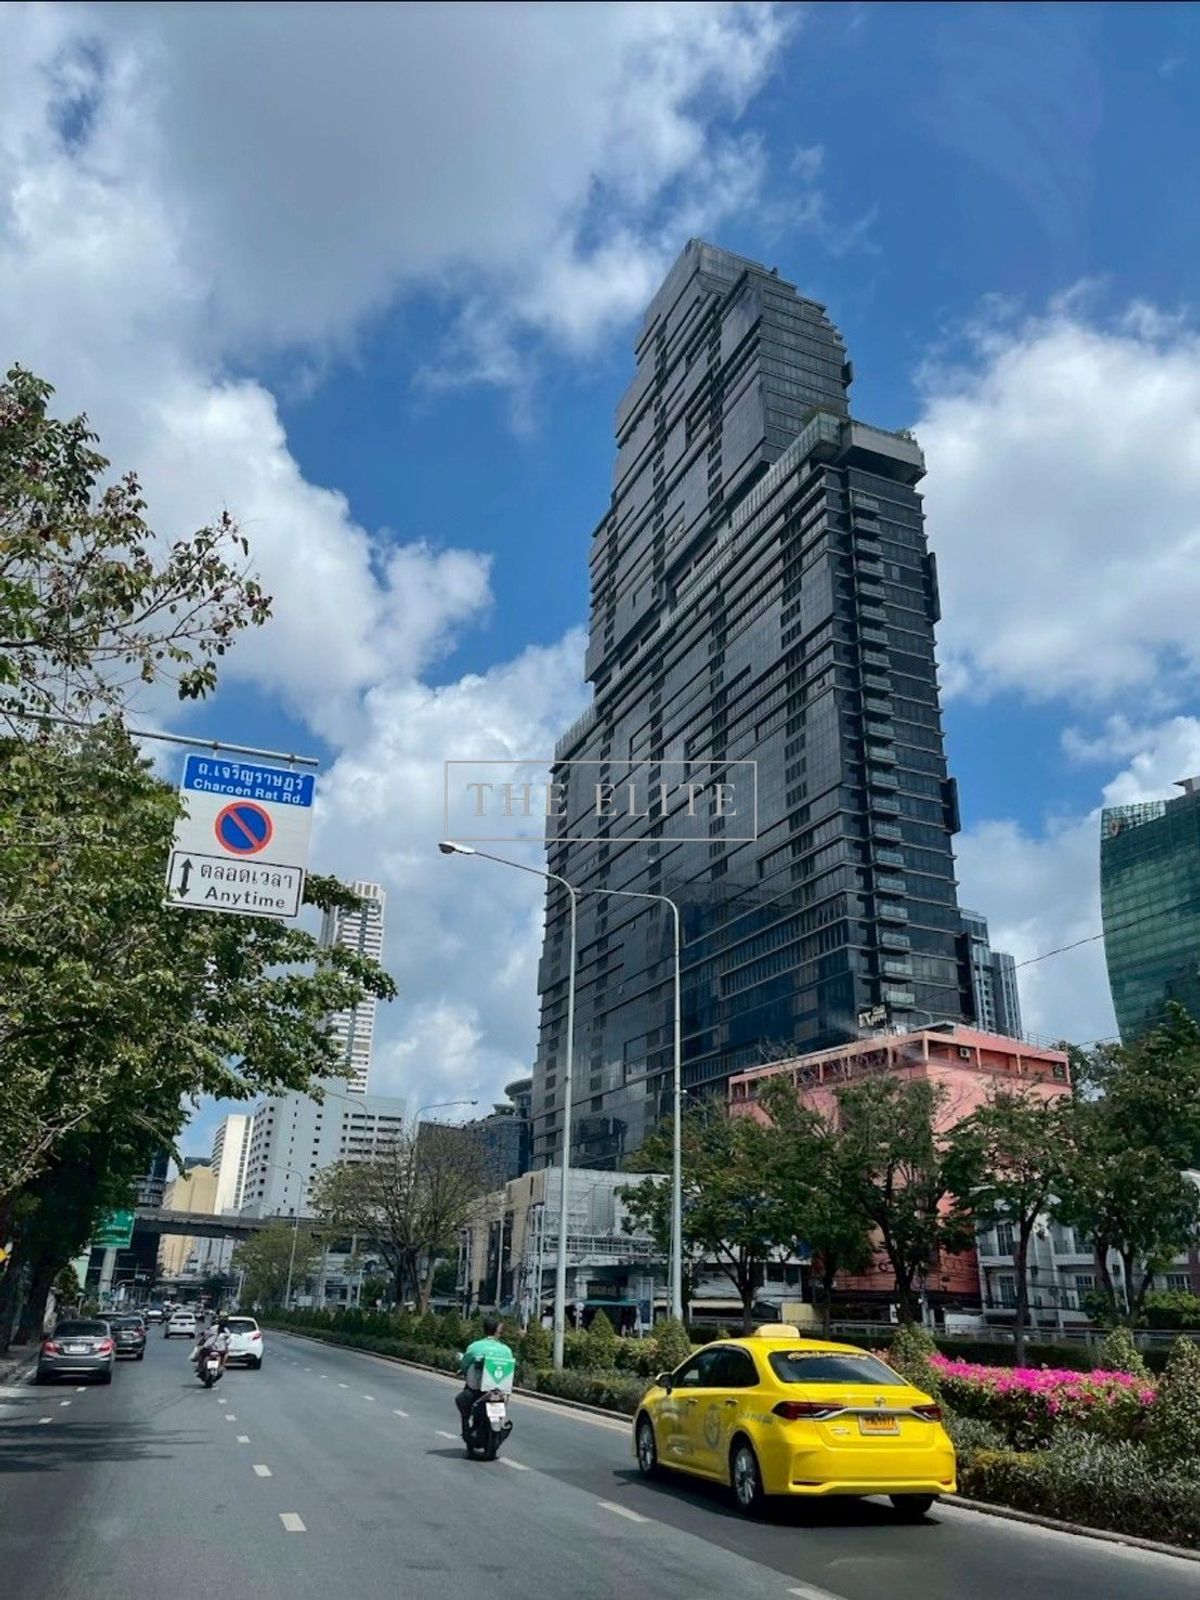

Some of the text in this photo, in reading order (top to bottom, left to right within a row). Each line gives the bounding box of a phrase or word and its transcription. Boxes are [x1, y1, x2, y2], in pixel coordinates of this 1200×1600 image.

[193, 778, 304, 804] Charoen Rat Rd.
[200, 863, 293, 888] ตลอดเวลา
[205, 887, 286, 909] Anytime
